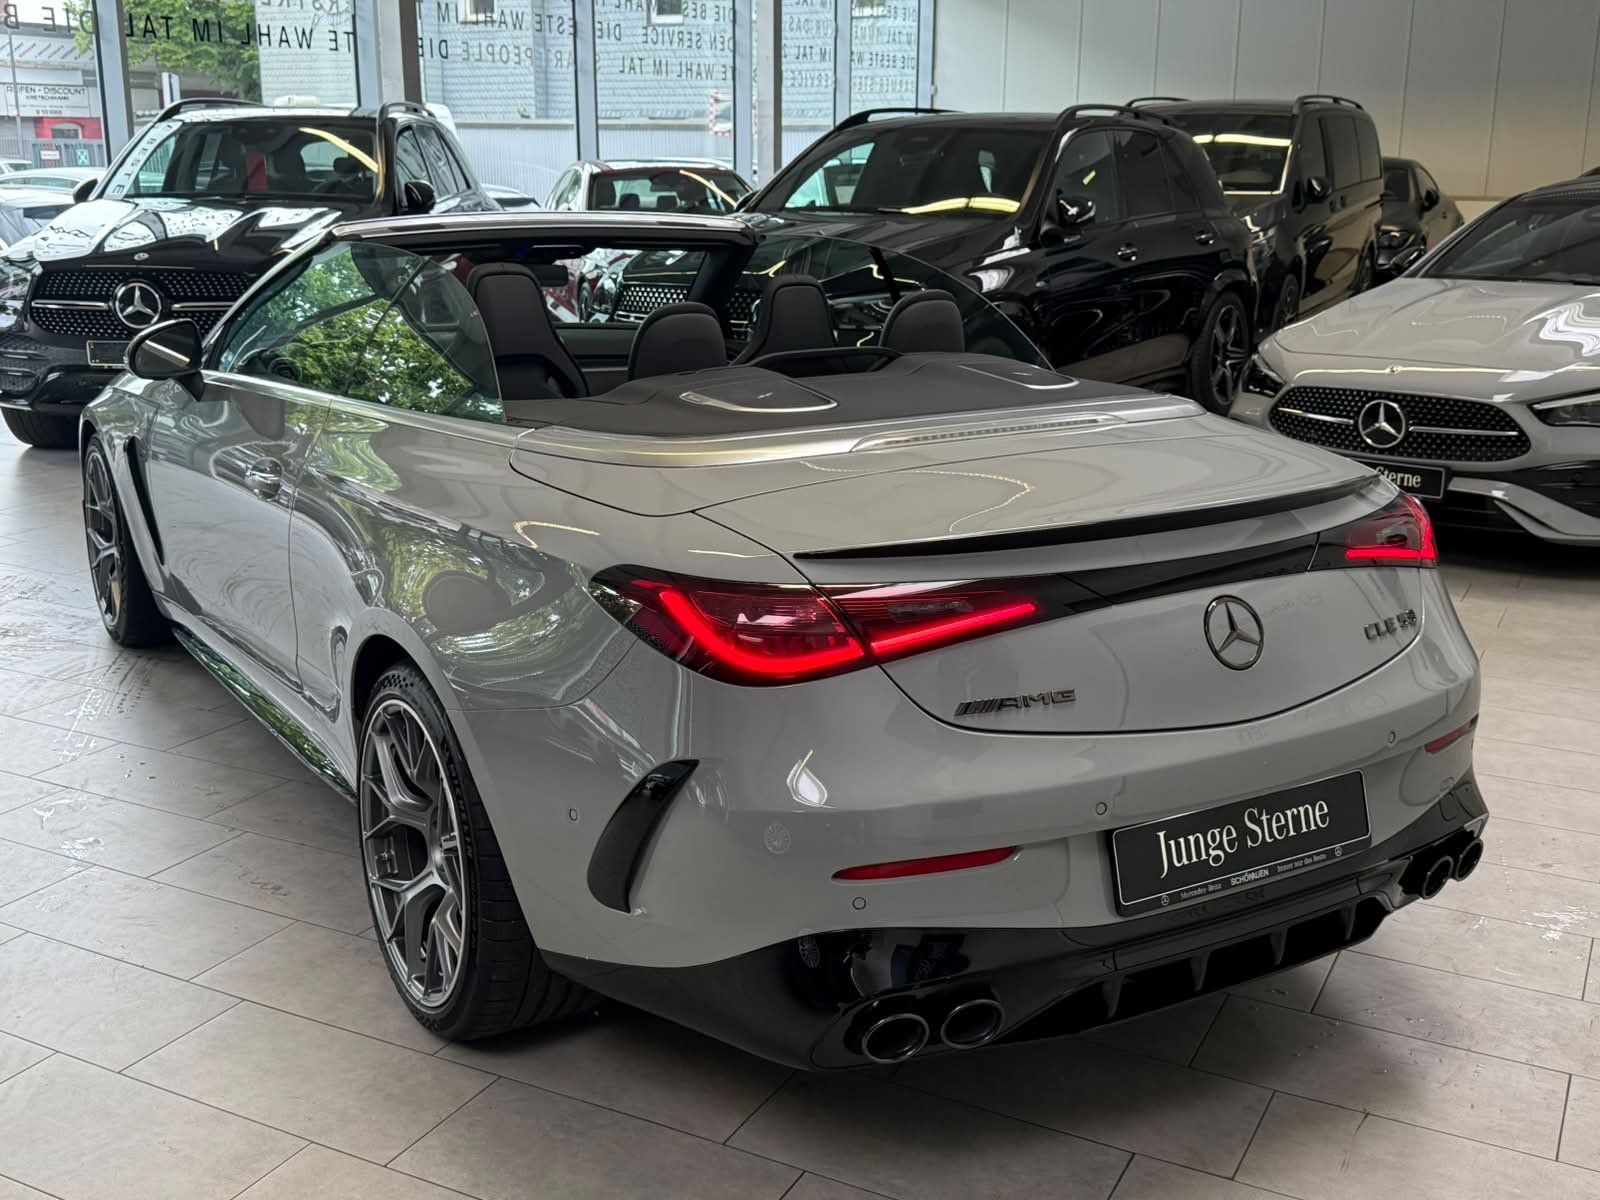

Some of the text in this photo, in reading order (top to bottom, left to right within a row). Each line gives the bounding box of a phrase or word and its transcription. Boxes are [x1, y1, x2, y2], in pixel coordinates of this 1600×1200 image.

[44, 86, 86, 96] DISCOUNT
[1363, 617, 1397, 640] CLE
[1156, 800, 1330, 878] Junge Sterne
